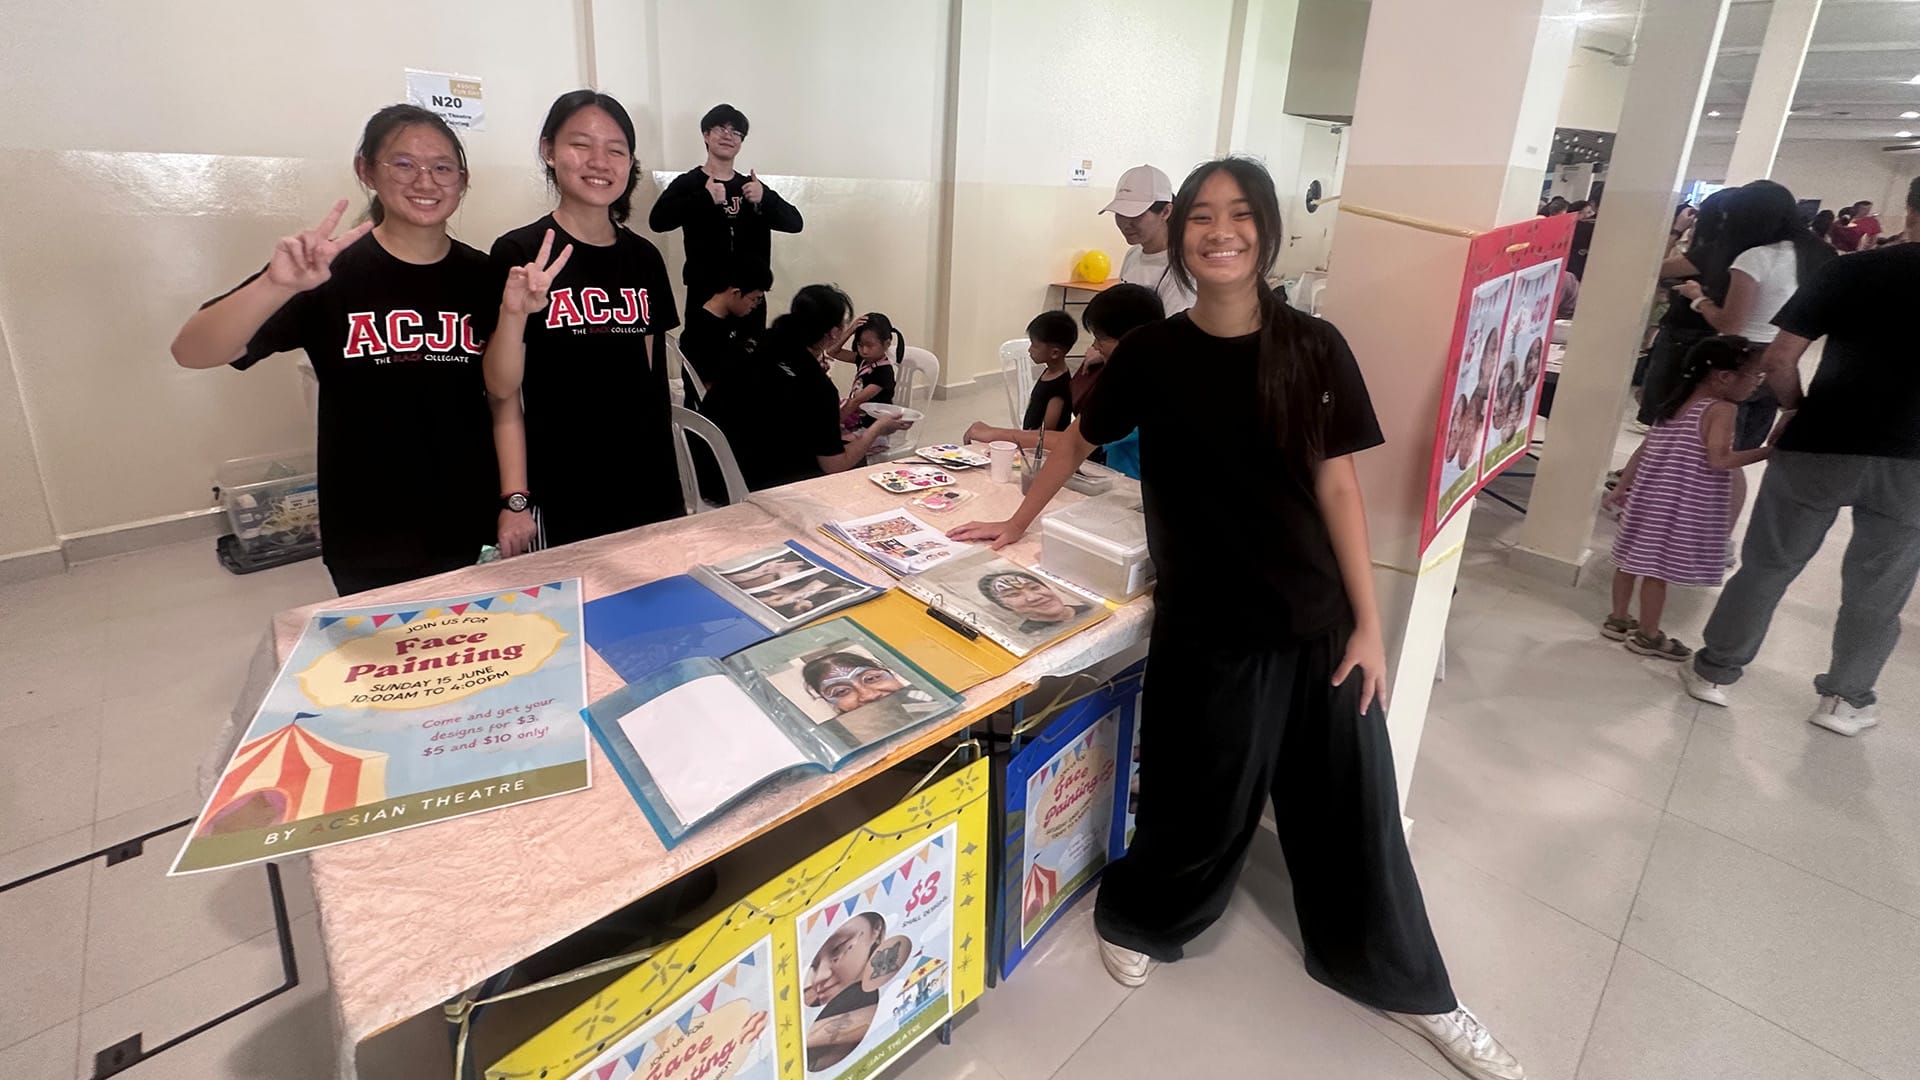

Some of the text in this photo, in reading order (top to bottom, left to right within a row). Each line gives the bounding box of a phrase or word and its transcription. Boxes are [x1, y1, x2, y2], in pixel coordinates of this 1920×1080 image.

[432, 95, 463, 109] N20
[611, 326, 647, 334] COLLEGIAT
[374, 356, 392, 365] THE
[406, 616, 489, 634] JOIN US FOR
[395, 631, 488, 656] Face
[344, 643, 526, 683] Painting
[350, 670, 510, 703] 10:00AM TO 4:00PM
[370, 666, 495, 692] SUNDAY 15 JUNE
[422, 697, 556, 729] Come and get your
[422, 726, 550, 757] $5 and $10 only!
[430, 726, 484, 742] designs
[488, 721, 511, 733] for
[263, 779, 525, 846] BY ACSIAN THEATRE
[905, 870, 942, 918] $3
[650, 1047, 671, 1070] JOIN
[671, 1034, 685, 1048] US
